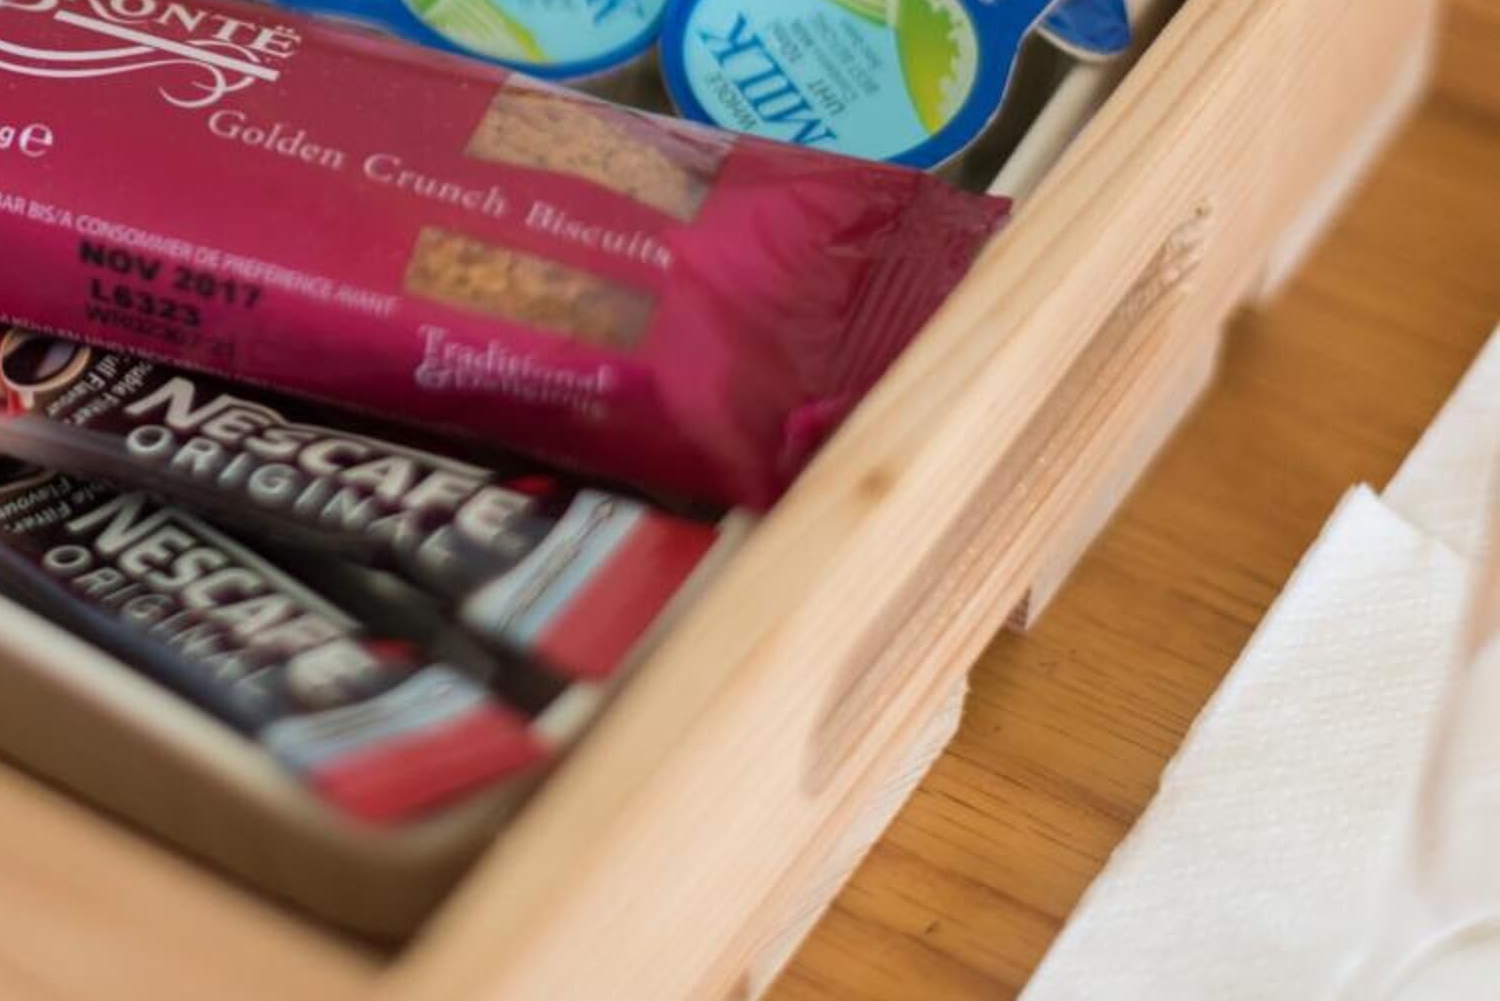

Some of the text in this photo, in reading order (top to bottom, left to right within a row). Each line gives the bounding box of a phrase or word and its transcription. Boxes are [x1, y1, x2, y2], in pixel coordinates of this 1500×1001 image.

[697, 11, 838, 146] MILK
[208, 108, 676, 271] Golden Crunch Biscuits
[77, 239, 265, 310] NOV 2017
[126, 423, 456, 570] ORIGINAL
